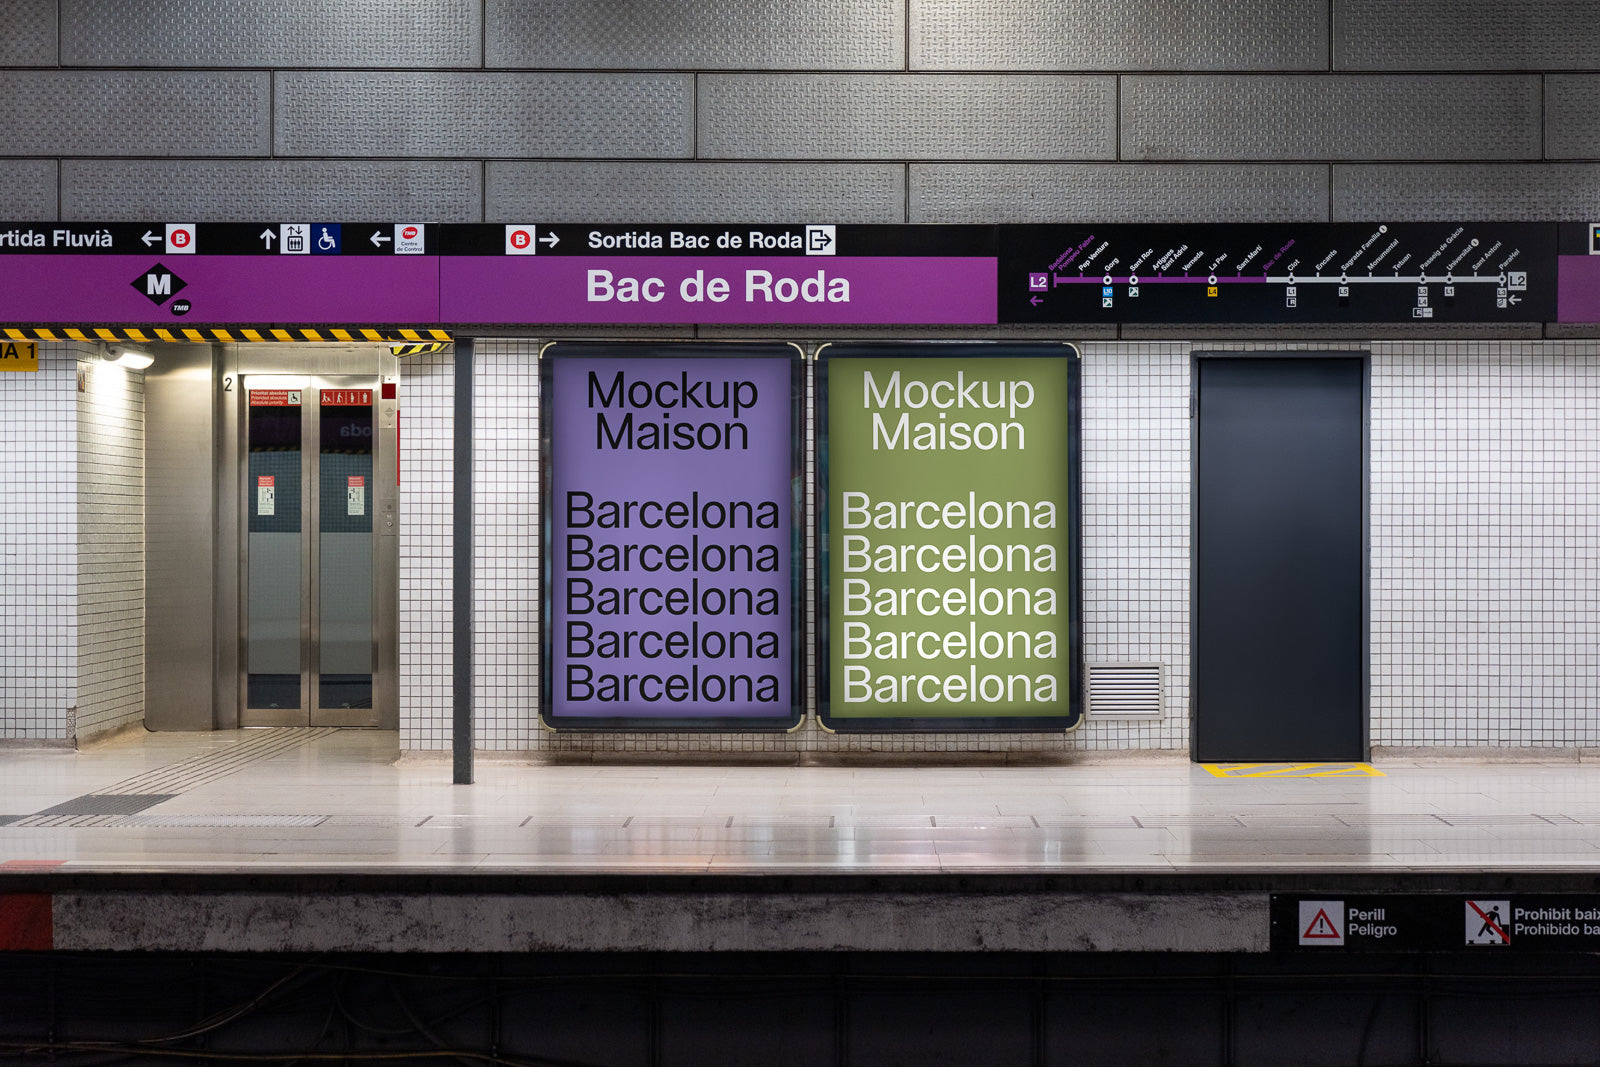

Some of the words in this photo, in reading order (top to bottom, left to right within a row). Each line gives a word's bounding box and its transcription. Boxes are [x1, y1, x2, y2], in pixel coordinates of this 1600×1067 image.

[53, 229, 113, 247] Fluvià
[176, 233, 186, 244] B
[516, 235, 525, 245] B
[588, 231, 663, 249] Sortida
[670, 231, 710, 249] Bac
[716, 231, 743, 249] de
[749, 231, 803, 249] Roda
[1420, 249, 1441, 270] Passeig
[1440, 243, 1447, 251] de
[1446, 227, 1464, 244] Gràcia
[1048, 247, 1073, 271] Badalona
[1058, 249, 1080, 271] Pompeu
[1078, 235, 1095, 250] Fabra
[1078, 260, 1090, 271] Pep
[1088, 241, 1109, 260] Ventura
[1105, 258, 1119, 271] Gorg
[1130, 258, 1143, 271] Sant
[1141, 248, 1153, 260] Roc
[1152, 249, 1174, 271] Artigues
[1161, 258, 1175, 271] Sant
[1173, 244, 1188, 260] Adrià
[1182, 250, 1204, 271] Verneda
[1209, 263, 1217, 271] La
[1215, 253, 1228, 264] Pau
[1236, 258, 1250, 271] Sant
[1248, 244, 1262, 259] Martí
[1262, 259, 1275, 271] Bac
[1274, 252, 1282, 260] de
[1280, 239, 1295, 253] Roda
[1287, 259, 1300, 271] Clot
[1315, 249, 1338, 271] Encants
[1341, 249, 1363, 271] Sagrada
[1367, 238, 1399, 271] Monumental
[1392, 253, 1412, 271] Tetuan
[1446, 244, 1473, 271] Universitat
[1472, 258, 1486, 271] Sant
[1484, 241, 1502, 258] Antoni
[147, 274, 171, 295] M
[587, 270, 665, 302] Bac
[679, 270, 730, 302] de
[745, 270, 851, 302] Roda
[1030, 277, 1047, 287] L2
[1510, 276, 1525, 286] L2
[0, 343, 19, 359] A
[27, 343, 34, 359] 1
[224, 377, 233, 391] 2
[588, 371, 758, 418] Mockup
[863, 371, 1035, 418] Mockup
[597, 412, 748, 450] Maison
[872, 412, 1025, 450] Maison
[566, 491, 779, 529] Barcelona
[843, 491, 1057, 529] Barcelona
[566, 534, 779, 572] Barcelona
[843, 535, 1057, 572] Barcelona
[566, 578, 779, 615] Barcelona
[843, 578, 1057, 615] Barcelona
[566, 621, 779, 658] Barcelona
[843, 621, 1057, 659] Barcelona
[566, 664, 779, 702] Barcelona
[843, 665, 1057, 702] Barcelona
[1349, 908, 1385, 921] Perill
[1514, 908, 1571, 920] Prohibit
[1349, 923, 1398, 938] Peligro
[1514, 923, 1580, 935] Prohibido
